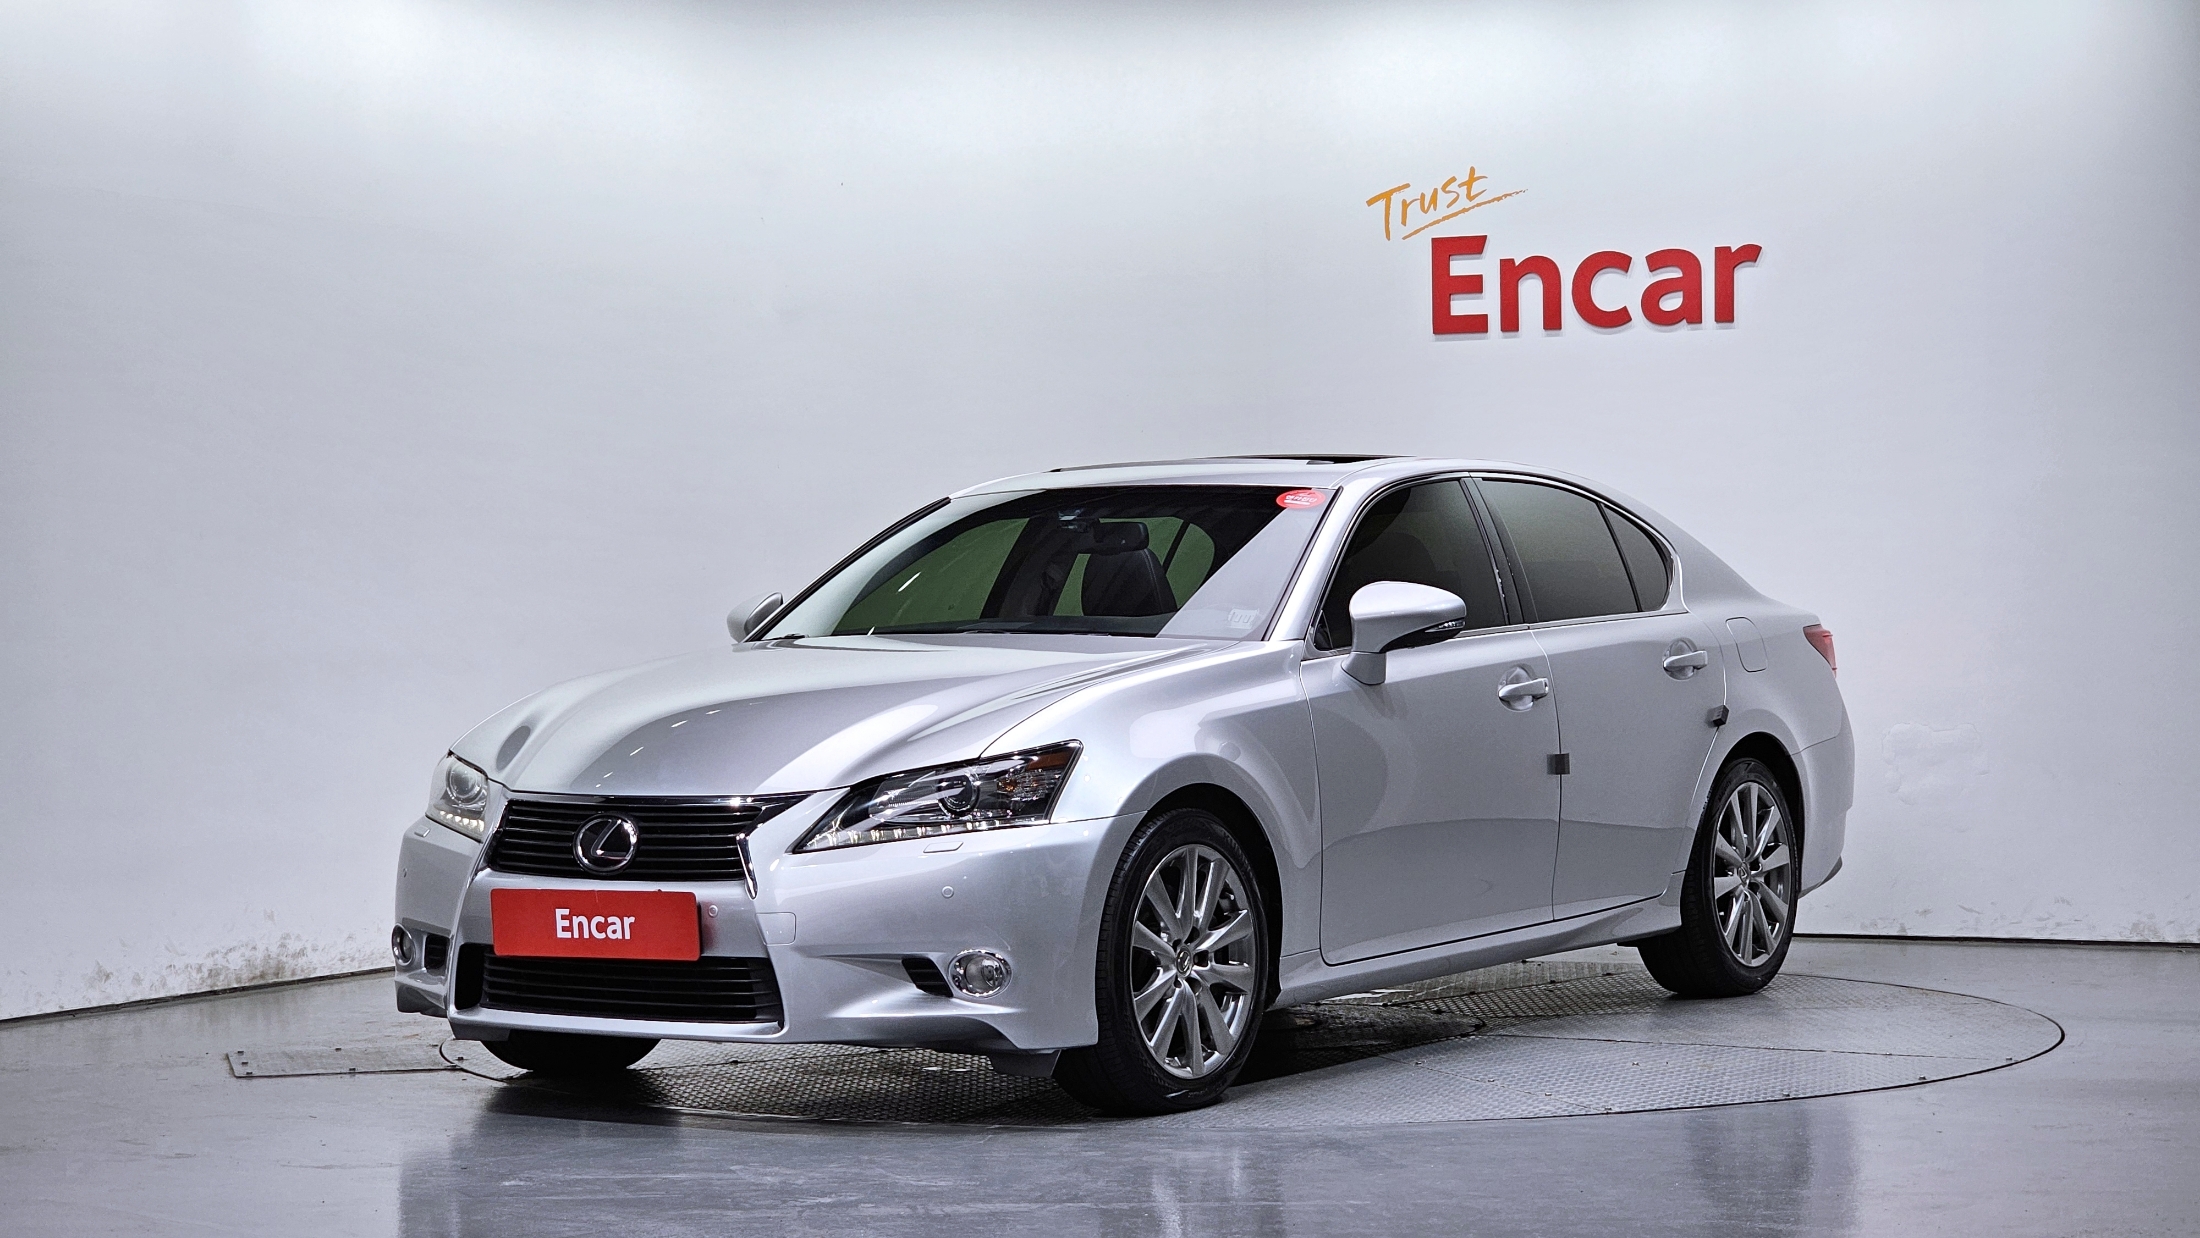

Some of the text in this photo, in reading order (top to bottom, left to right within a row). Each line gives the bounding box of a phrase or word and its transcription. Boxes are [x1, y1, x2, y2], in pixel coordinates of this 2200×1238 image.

[1366, 166, 1489, 241] Trust
[1431, 235, 1762, 335] Encar
[555, 908, 636, 940] Encar
